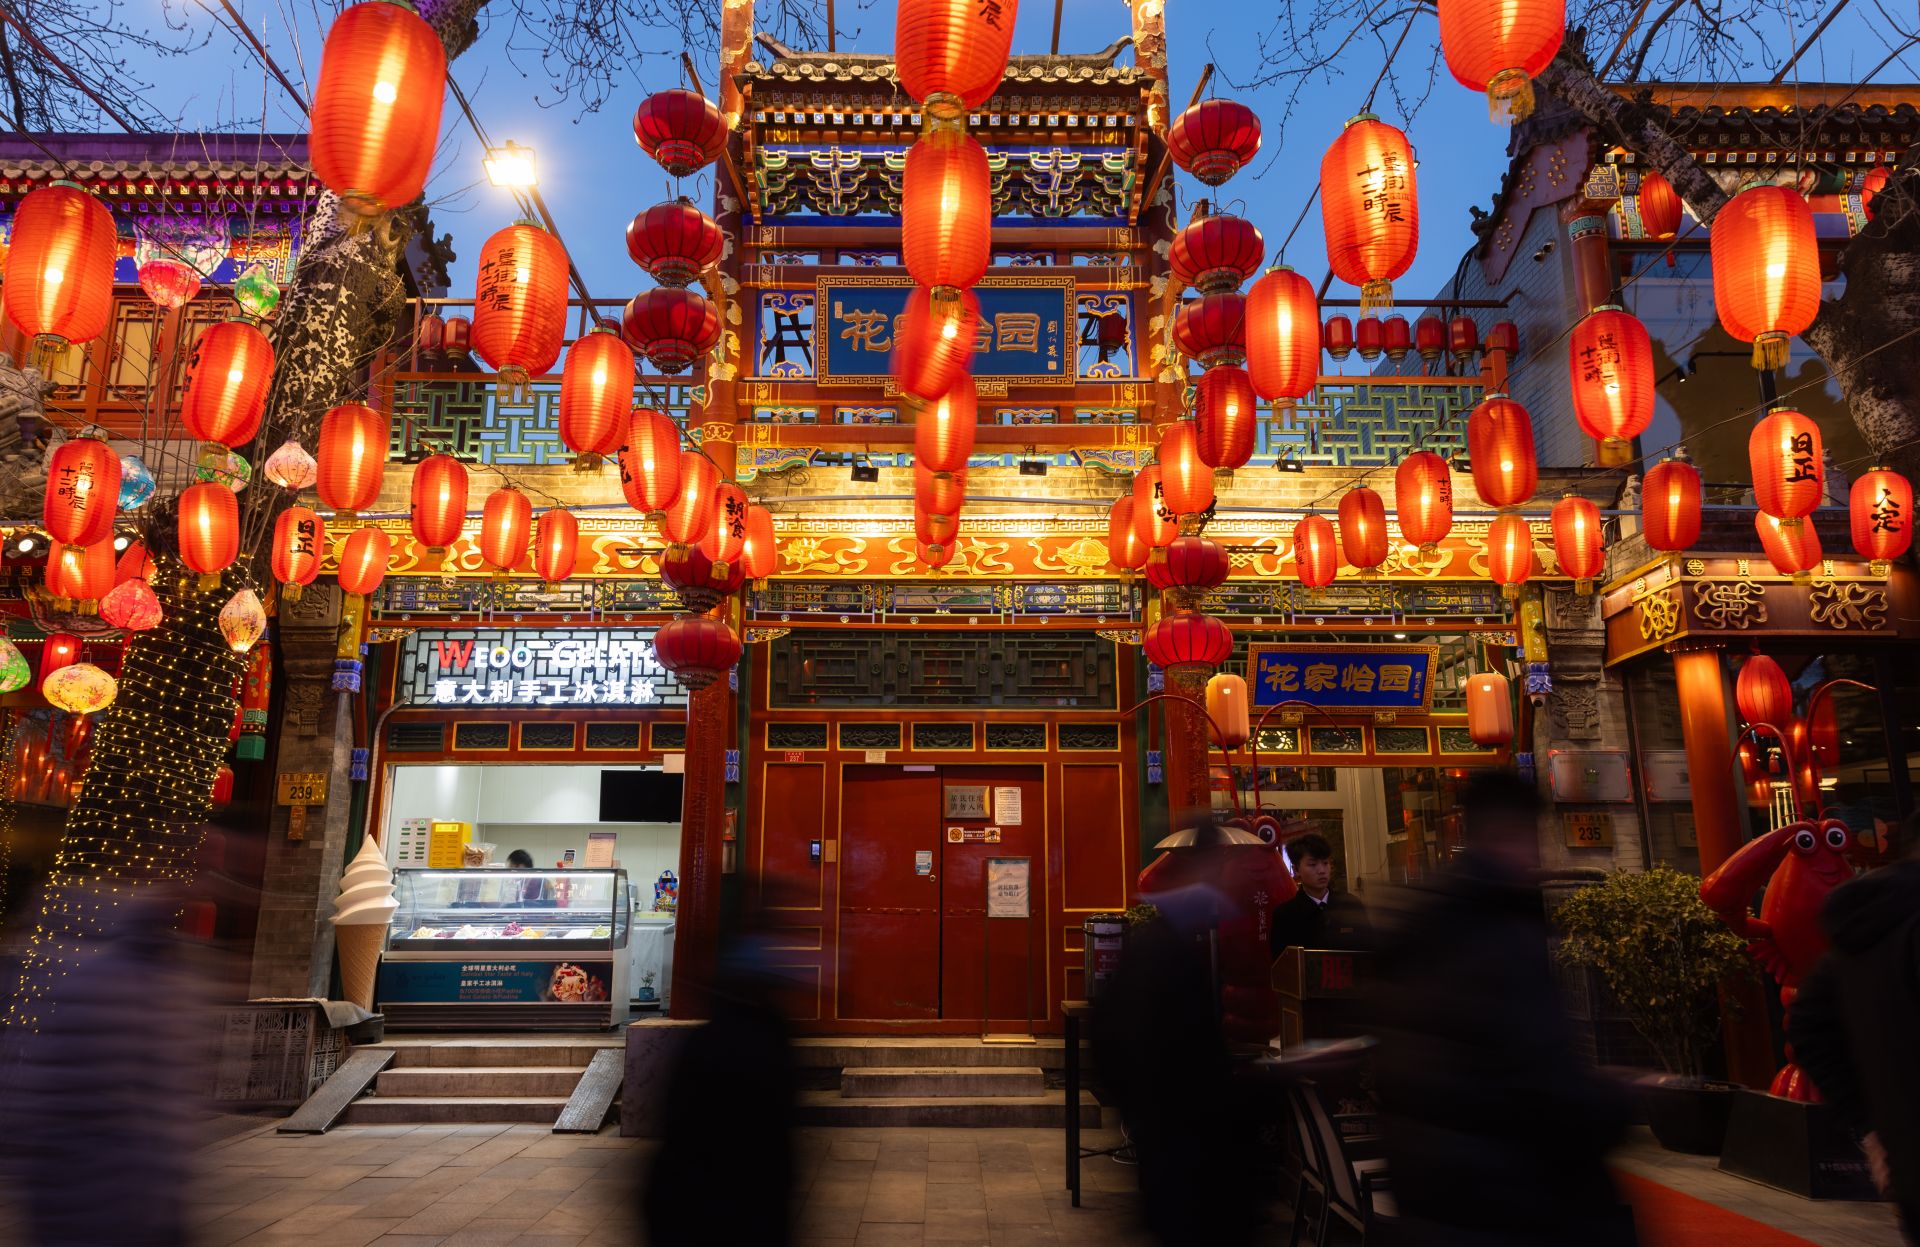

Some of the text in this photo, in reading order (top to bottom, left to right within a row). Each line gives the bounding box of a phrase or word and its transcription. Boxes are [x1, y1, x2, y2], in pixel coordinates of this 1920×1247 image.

[841, 309, 1040, 353] 花园
[725, 496, 746, 539] 朝食
[1870, 488, 1901, 534] 人定
[436, 640, 533, 669] WEOO
[434, 680, 655, 704] 意大利手工冰淇淋
[1265, 662, 1413, 693] 花家怡园
[289, 786, 313, 800] 239
[1578, 827, 1602, 841] 235
